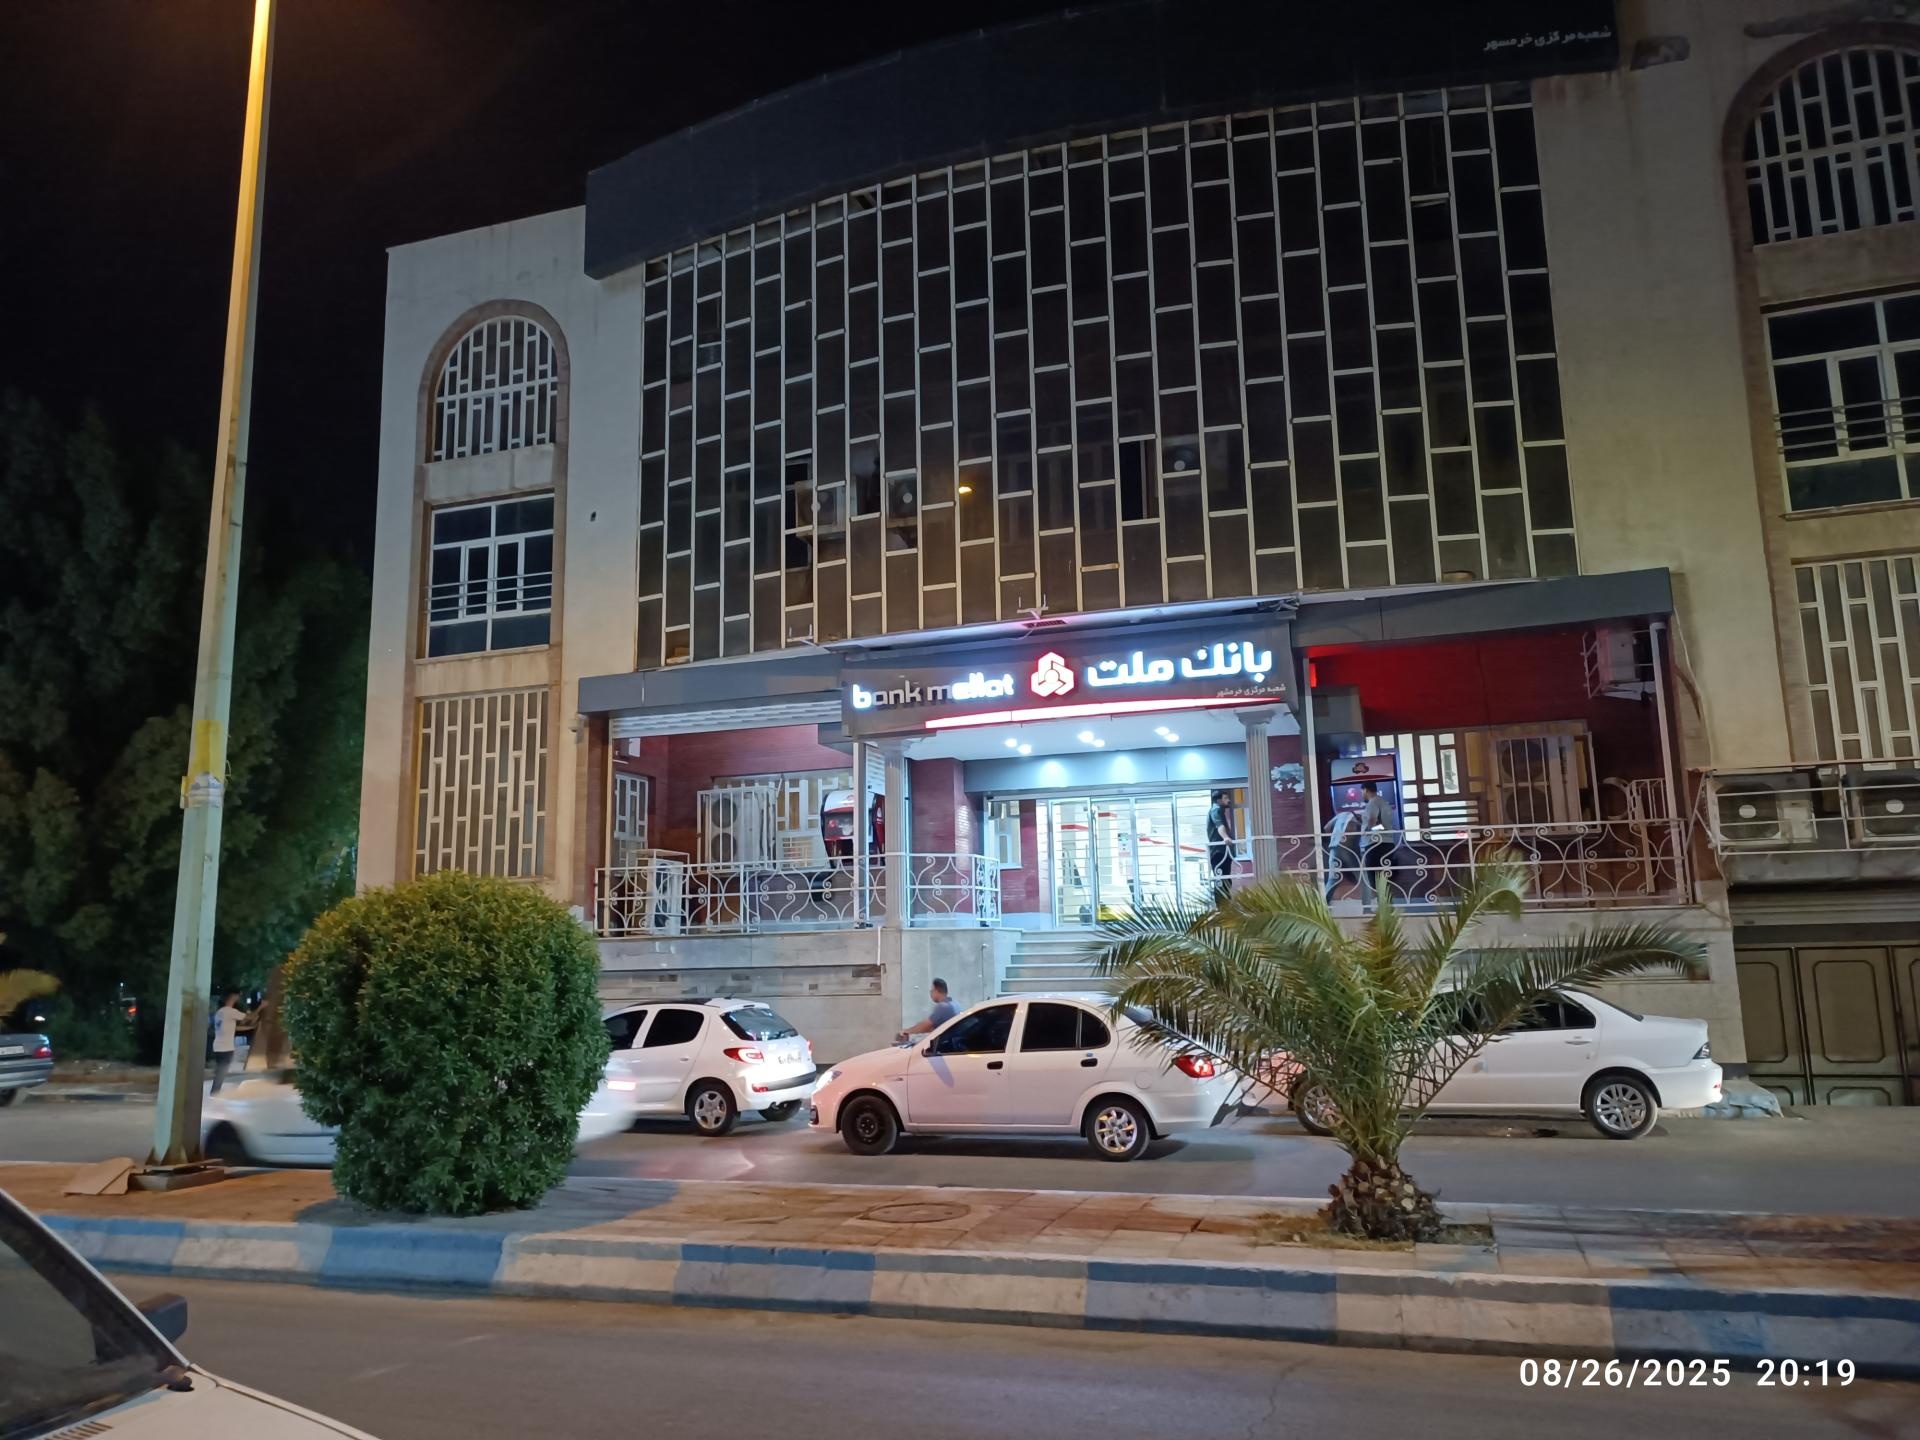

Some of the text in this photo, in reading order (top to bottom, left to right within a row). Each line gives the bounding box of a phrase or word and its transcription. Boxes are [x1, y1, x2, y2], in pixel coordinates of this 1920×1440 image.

[1087, 651, 1175, 687] ملت
[852, 672, 1014, 709] bank mellat
[1244, 686, 1266, 696] مرکزی
[1267, 683, 1286, 694] شعبه
